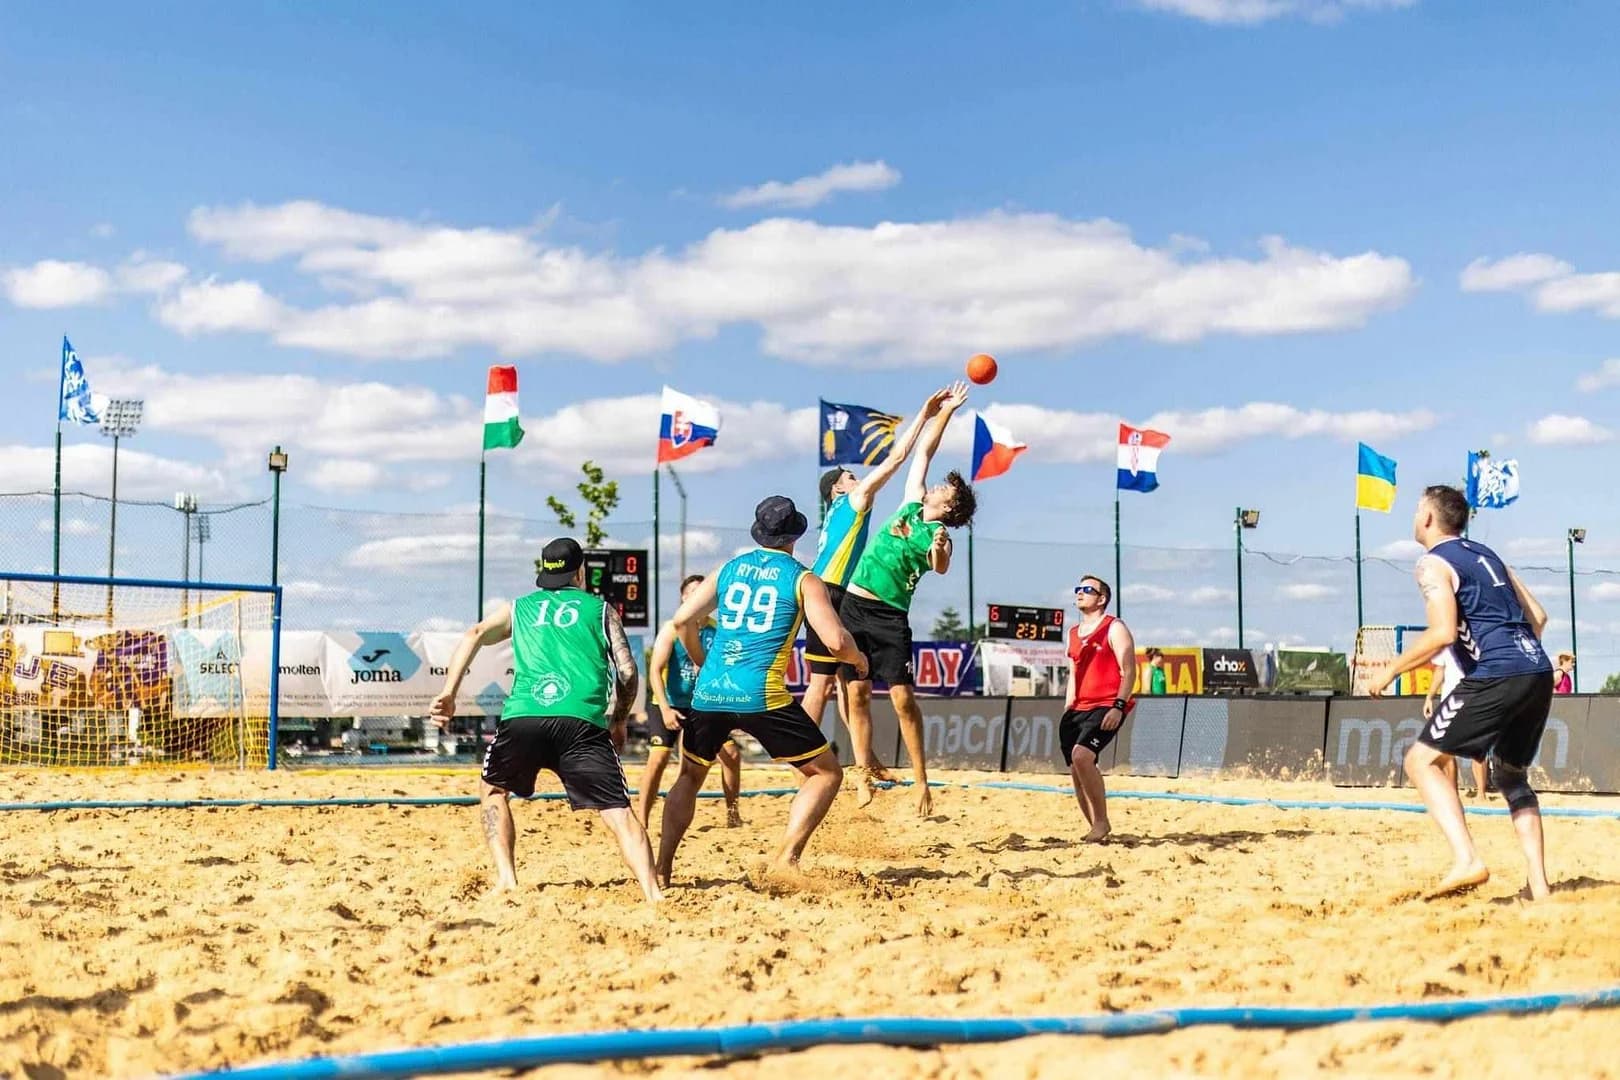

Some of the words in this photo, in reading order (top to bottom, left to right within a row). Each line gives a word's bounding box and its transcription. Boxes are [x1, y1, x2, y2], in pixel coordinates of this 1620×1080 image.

[737, 562, 781, 581] RYTMUS
[1477, 555, 1506, 588] 1
[531, 599, 582, 628] 16
[721, 581, 779, 634] 99
[1015, 623, 1047, 640] 2:31
[278, 664, 321, 676] molten
